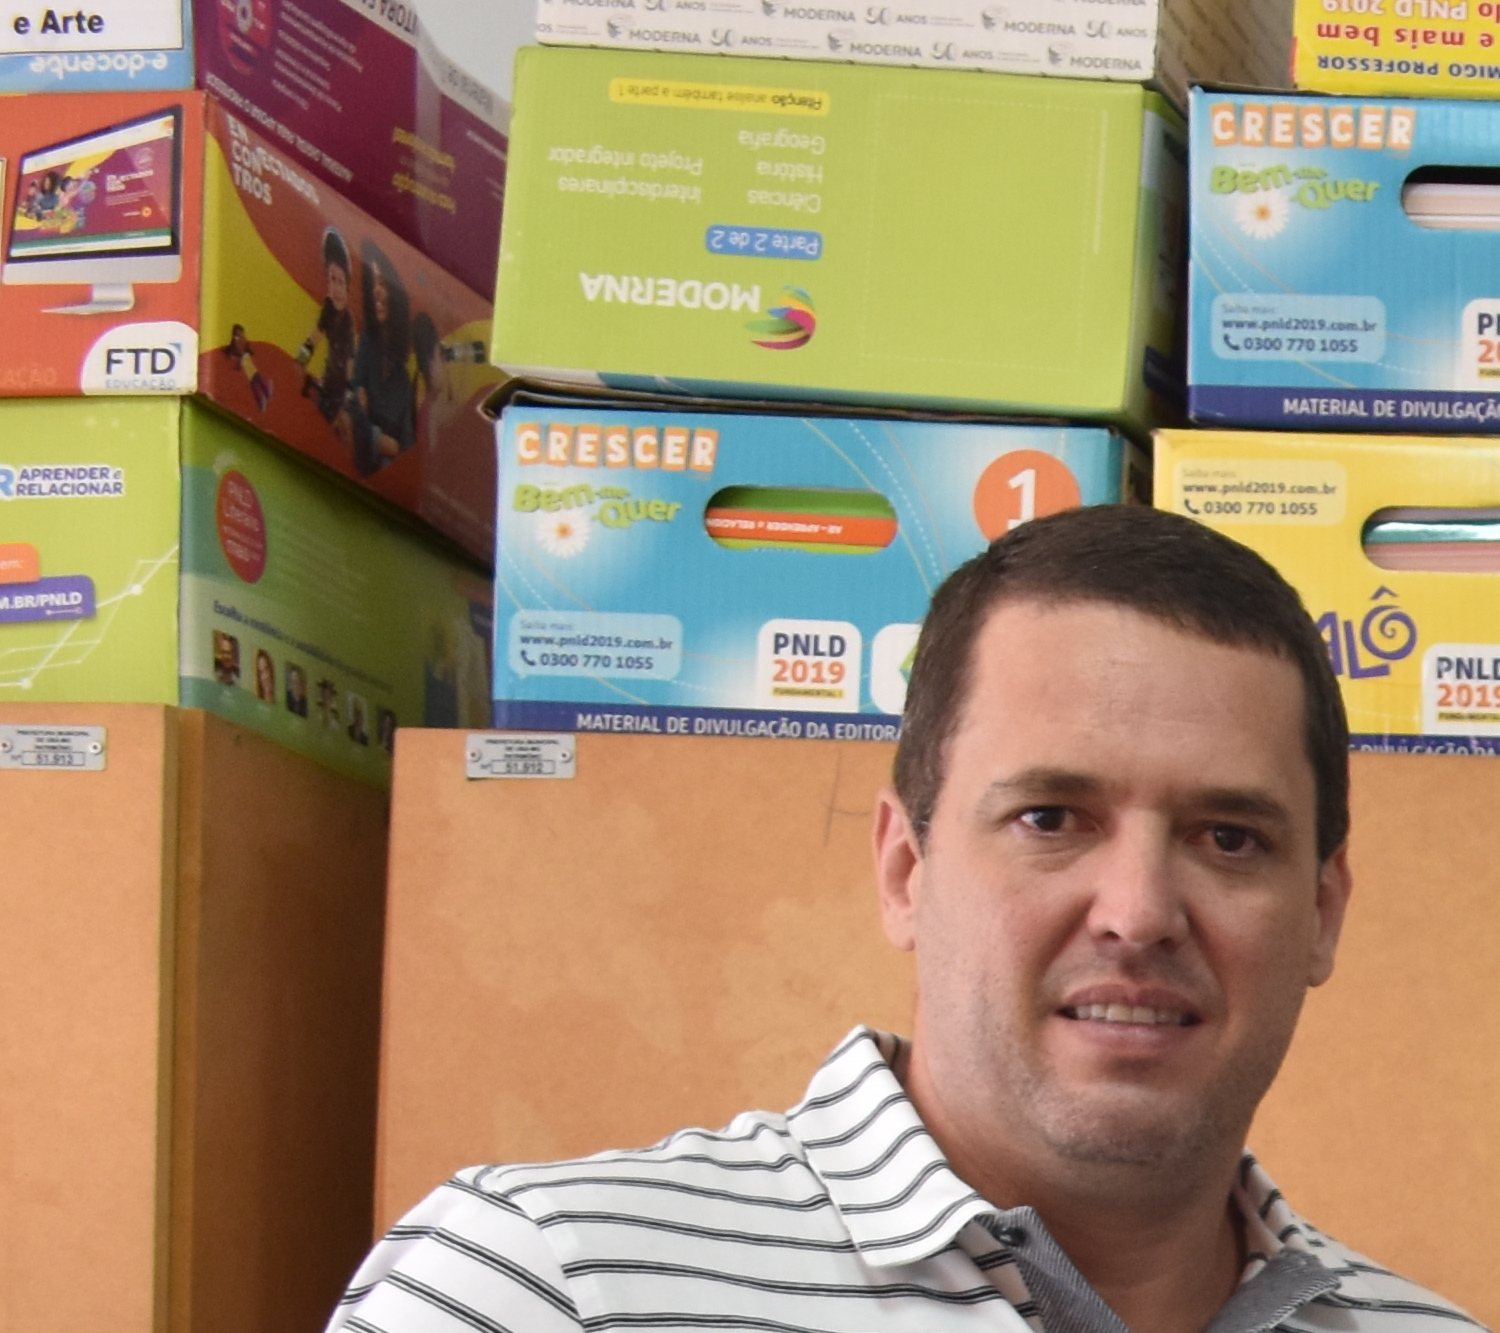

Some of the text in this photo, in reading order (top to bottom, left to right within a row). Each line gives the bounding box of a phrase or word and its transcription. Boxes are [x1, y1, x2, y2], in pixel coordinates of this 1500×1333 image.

[784, 7, 928, 26] MODERNA ANOS
[1403, 0, 1466, 19] PNLD
[13, 9, 105, 35] e Arte
[1003, 19, 1076, 38] MODERNA
[629, 29, 701, 44] MODERNA
[1317, 23, 1378, 47] bem
[1396, 27, 1465, 46] mais
[1479, 33, 1494, 48] e
[850, 41, 921, 58] MODERNA
[1318, 56, 1439, 77] PROFESSOR
[1210, 104, 1415, 149] CRESCER
[739, 128, 826, 155] Geografia
[548, 145, 703, 176] Projeto integrador
[757, 160, 823, 183] História
[747, 188, 822, 213] Ciências
[711, 230, 819, 256] Parte 2 de 2
[579, 272, 760, 313] MODERNA
[1243, 336, 1358, 352] 0300 770 1055
[105, 345, 181, 375] FTD
[105, 377, 176, 390] EDUCAÇÃO
[1283, 397, 1367, 416] MATERIAL
[1374, 399, 1396, 417] DE
[516, 423, 719, 471] CRESCER
[19, 467, 110, 481] APRENDER
[16, 481, 123, 496] RELACIONAR
[1203, 500, 1318, 517] 0300 770 1055
[1313, 586, 1417, 680] ALÔ
[773, 632, 846, 658] PNLD
[540, 652, 654, 670] 0300 770 1055
[772, 659, 846, 684] 2019
[577, 712, 660, 733] MATERIAL
[666, 715, 689, 733] DE
[694, 714, 800, 740] DIVULGAÇÃO
[806, 721, 830, 738] DA
